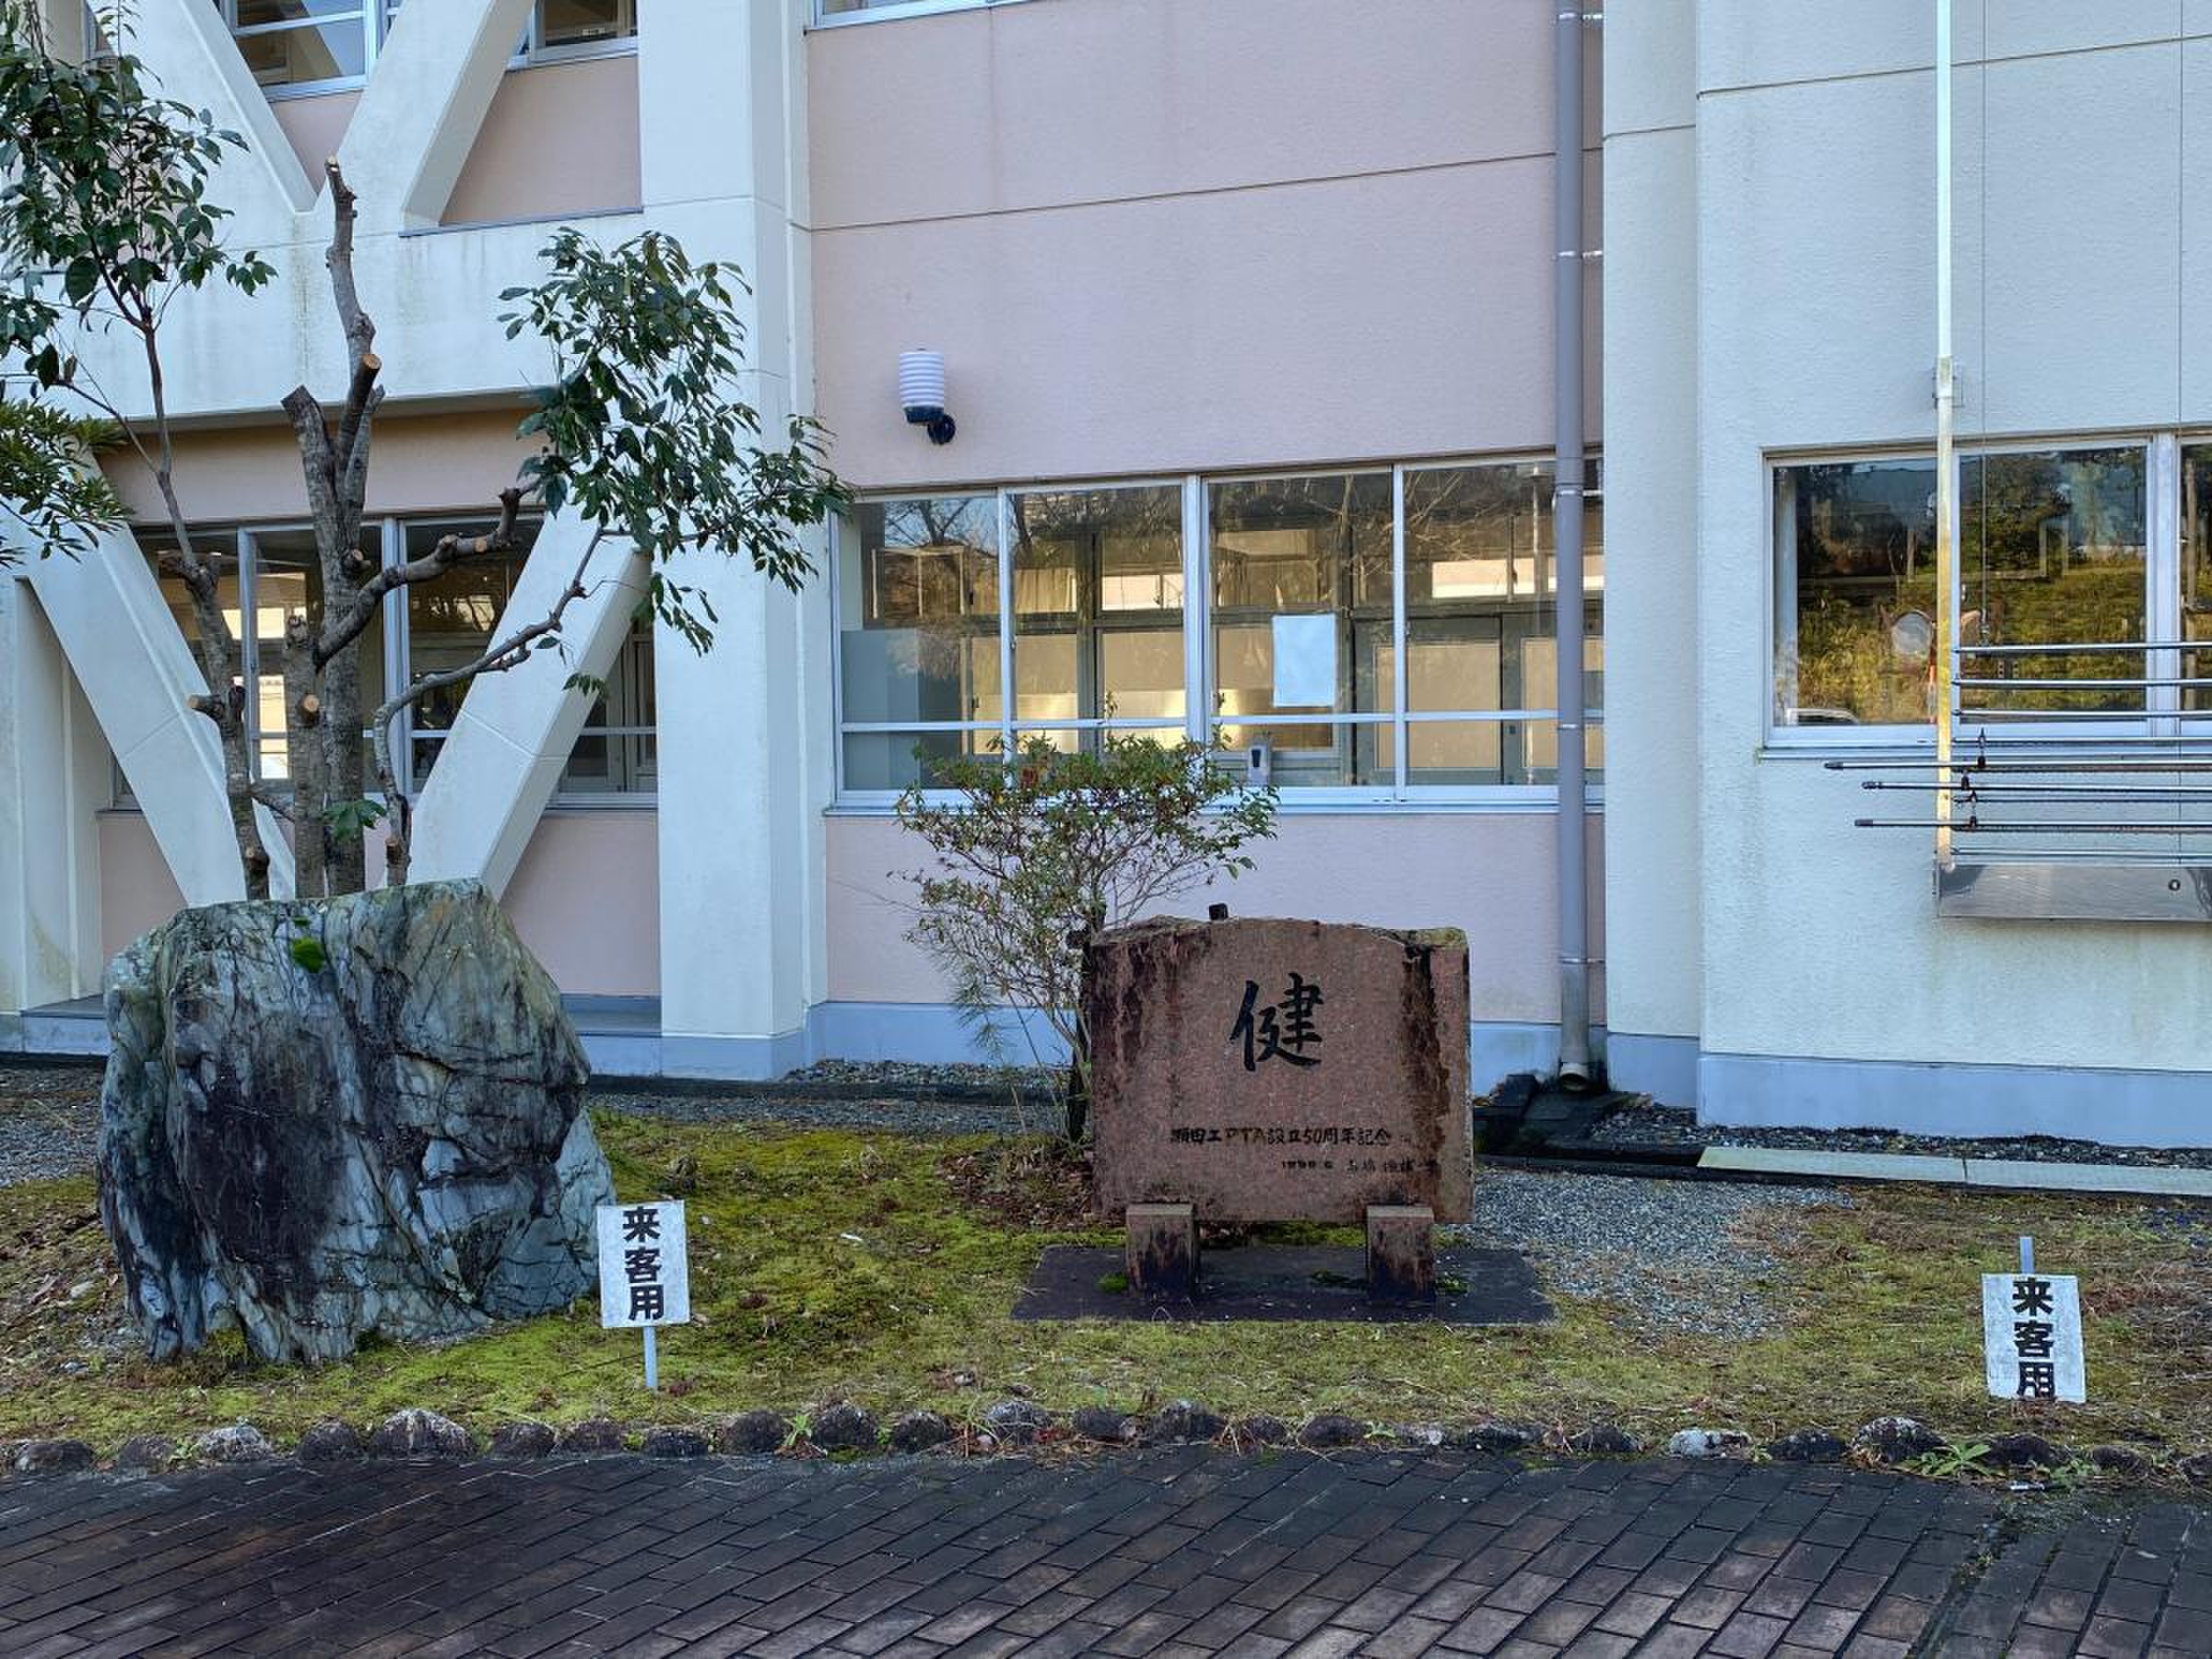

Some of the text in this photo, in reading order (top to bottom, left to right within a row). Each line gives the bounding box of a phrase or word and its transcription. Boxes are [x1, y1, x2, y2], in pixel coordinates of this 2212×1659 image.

[1230, 973, 1324, 1072] 健
[622, 1206, 665, 1322] 来客用
[2012, 1277, 2056, 1398] 来客用
